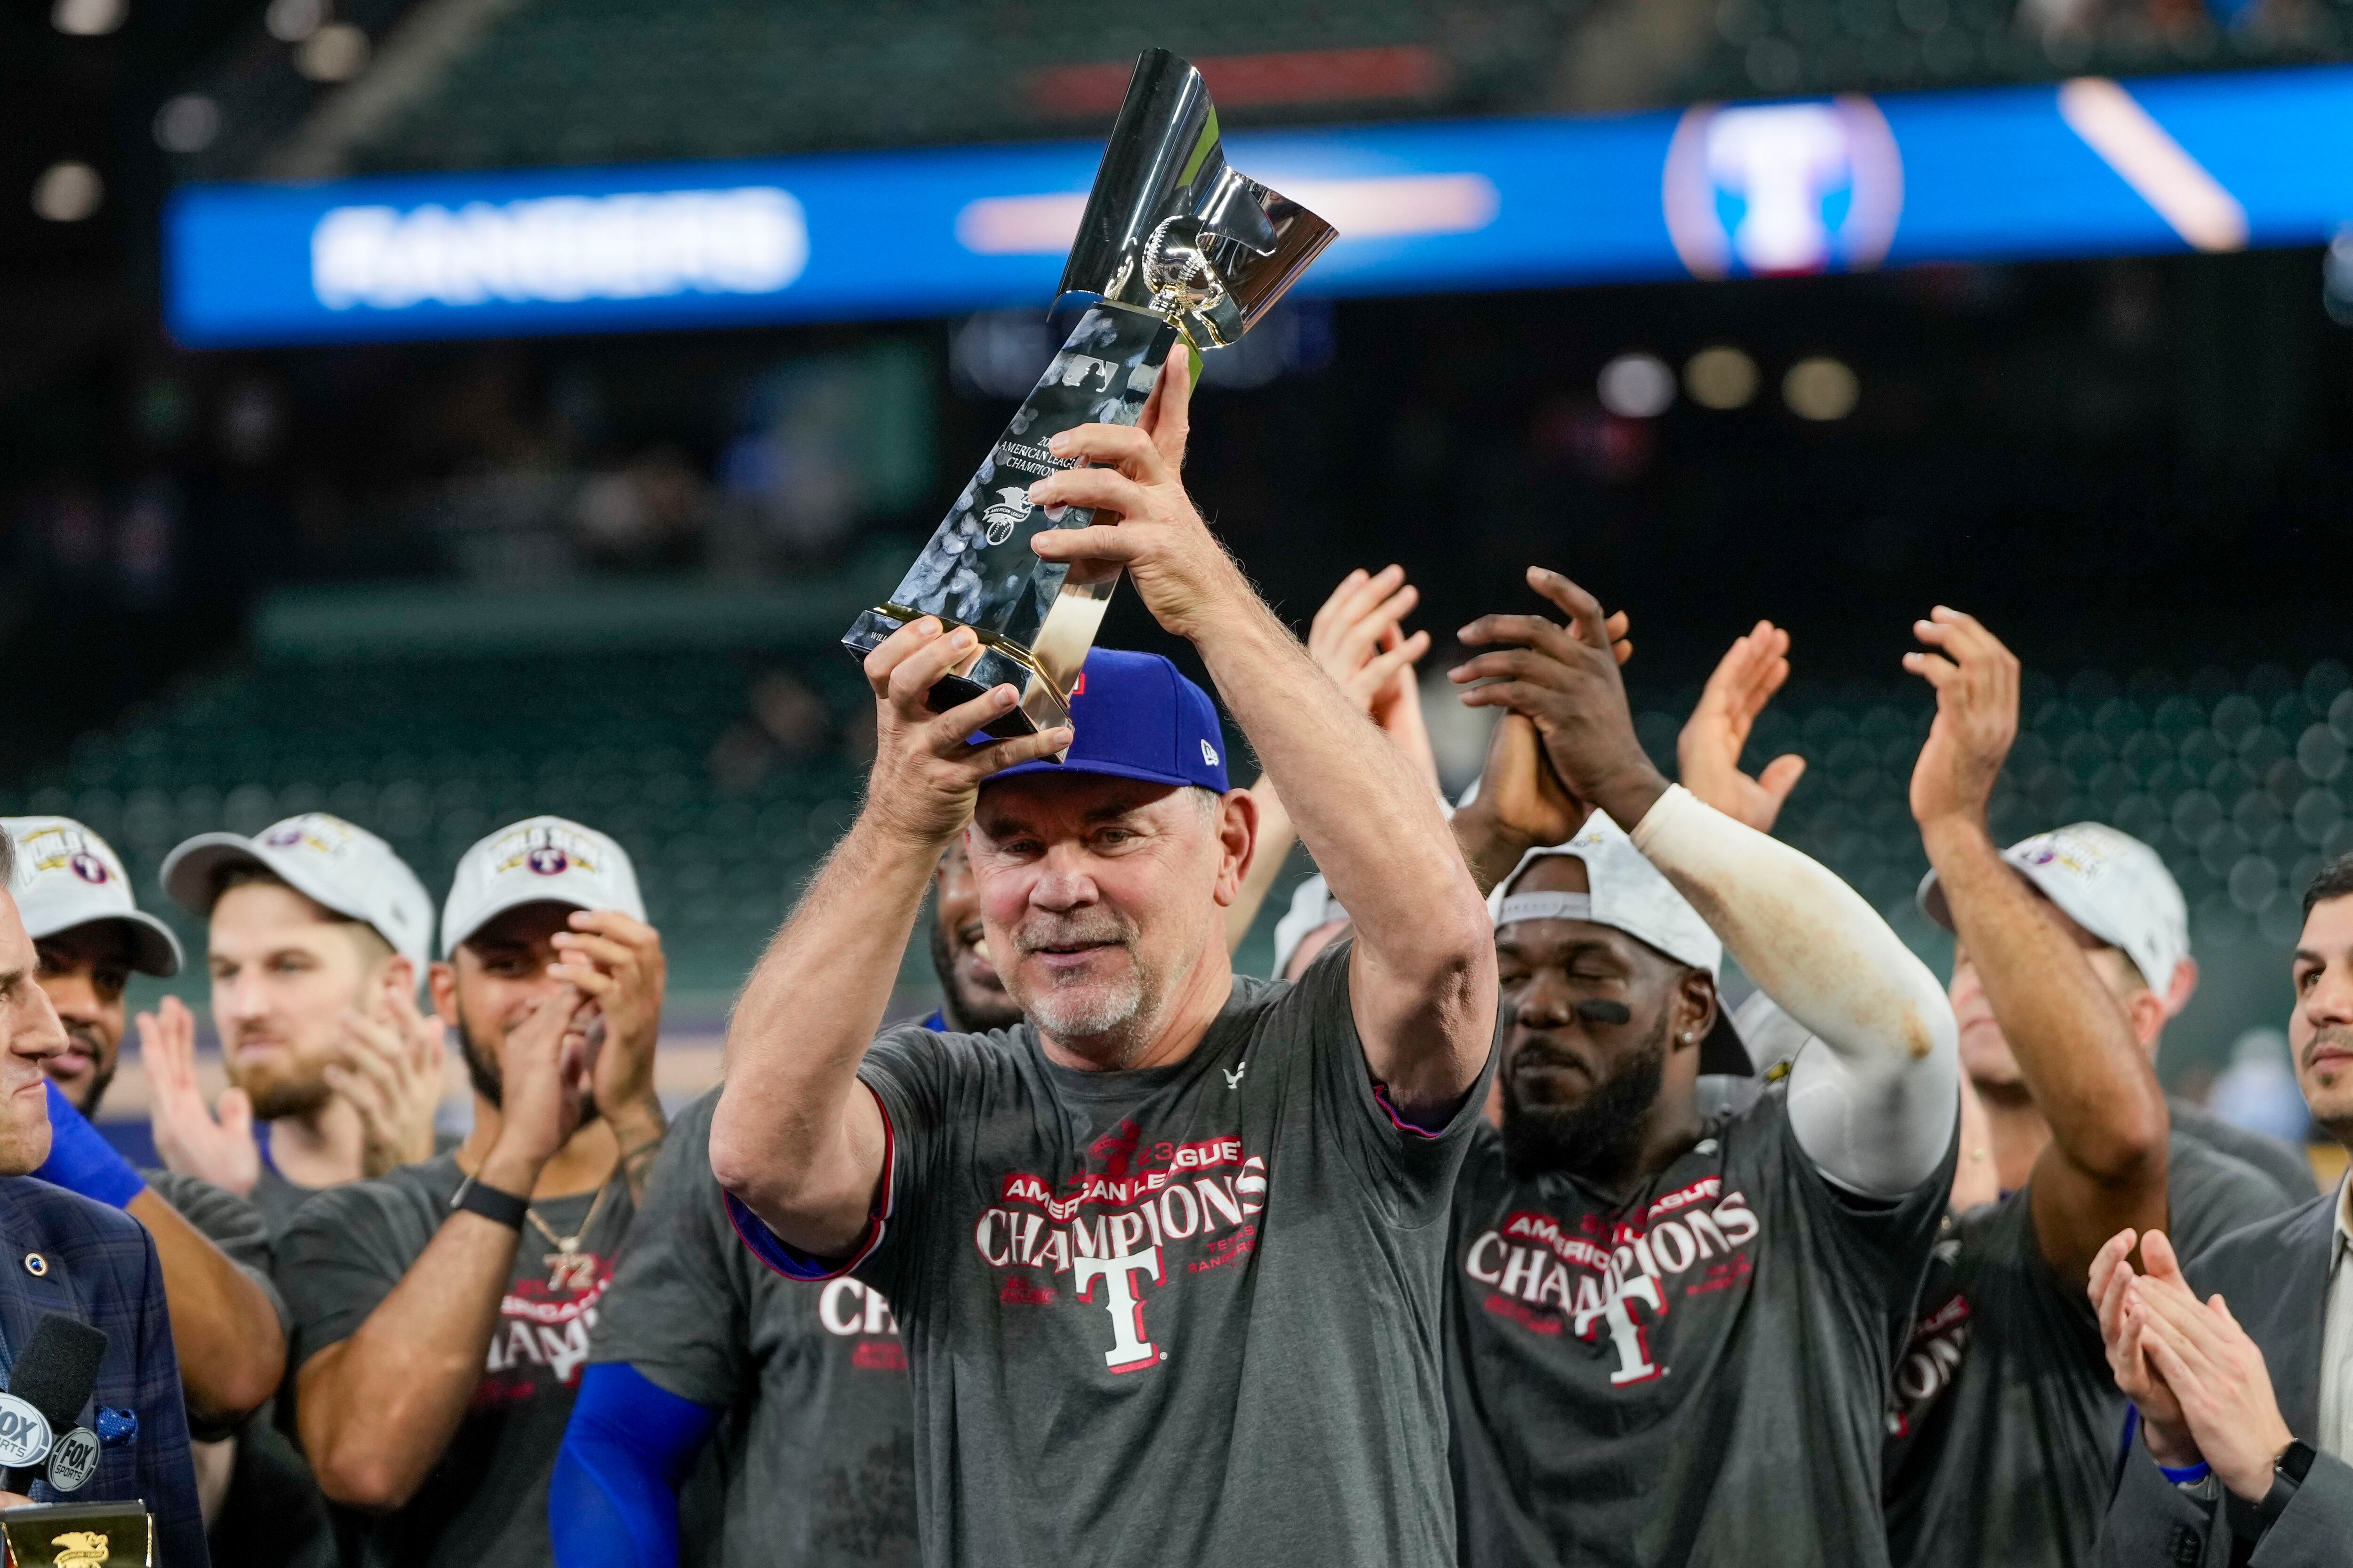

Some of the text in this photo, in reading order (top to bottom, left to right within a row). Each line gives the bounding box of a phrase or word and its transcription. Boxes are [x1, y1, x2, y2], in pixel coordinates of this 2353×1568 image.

[999, 441, 1081, 469] AMERICAN LEAGU
[1006, 457, 1058, 477] CHAMPION
[871, 632, 888, 642] WILL
[976, 1156, 1268, 1274] CHAMPIONS
[1006, 1179, 1127, 1220] AMERCAN
[1466, 1191, 1759, 1316] CHAMPIONS
[1508, 1216, 1618, 1272] AMERIC
[1074, 1246, 1166, 1374] T
[1574, 1274, 1669, 1387] T
[0, 1406, 38, 1448] OX
[0, 1437, 26, 1458] RTS
[54, 1464, 82, 1481] SPORTS
[60, 1439, 94, 1471] FOX
